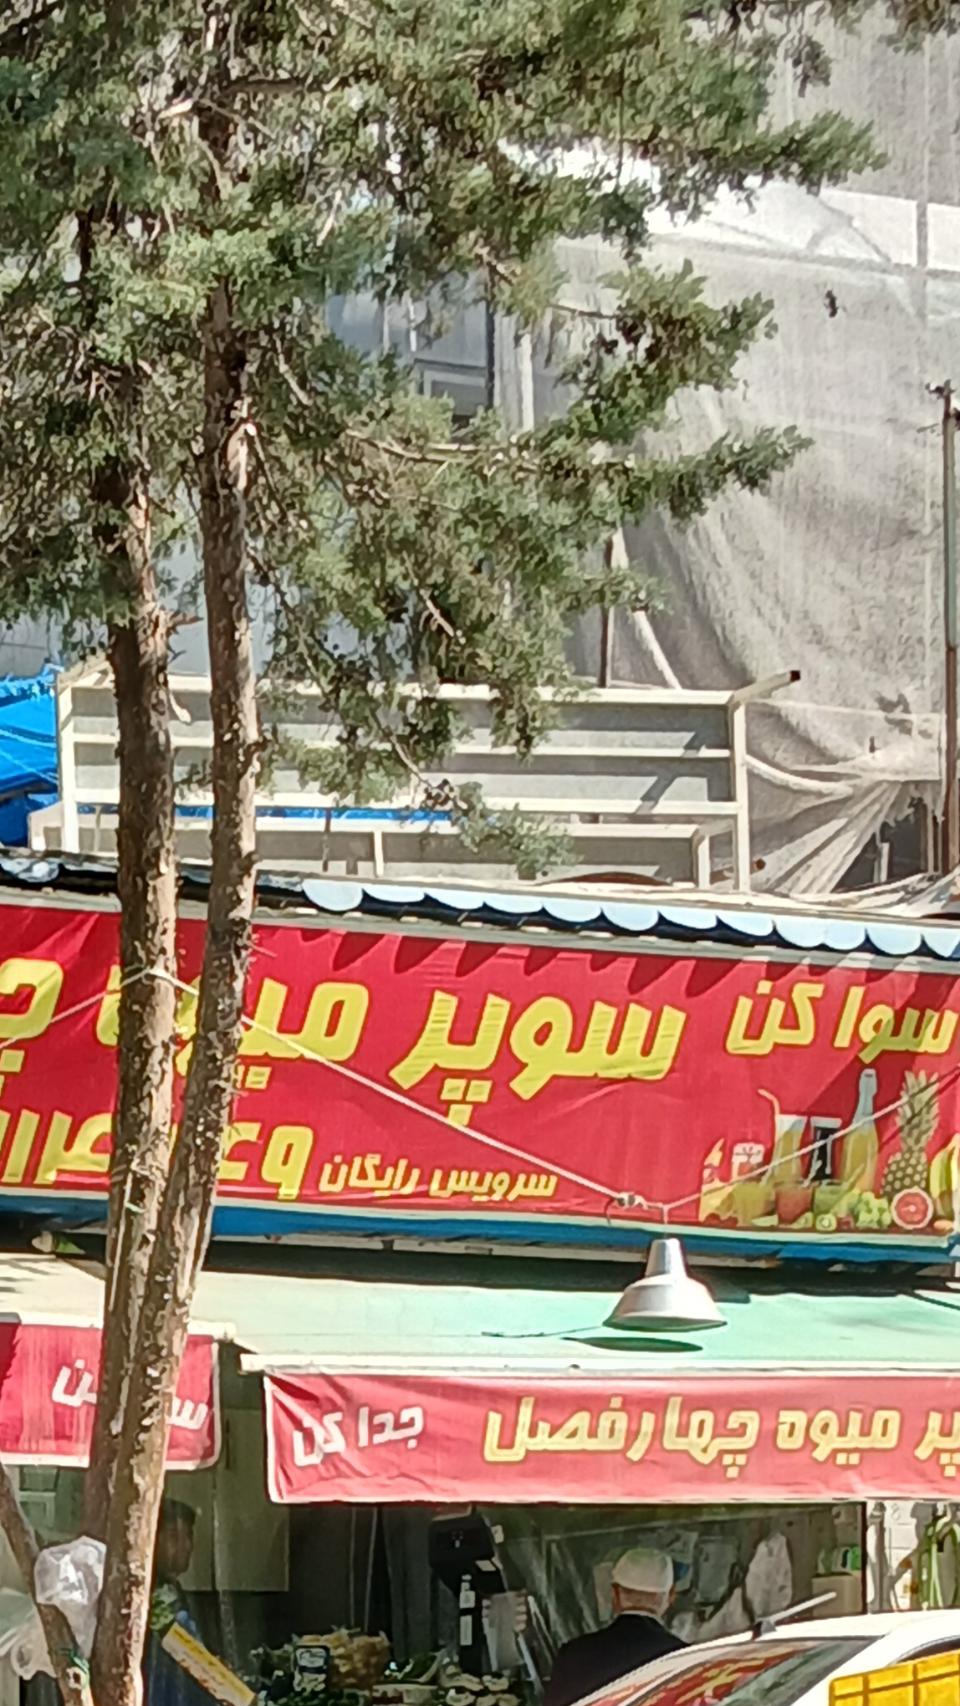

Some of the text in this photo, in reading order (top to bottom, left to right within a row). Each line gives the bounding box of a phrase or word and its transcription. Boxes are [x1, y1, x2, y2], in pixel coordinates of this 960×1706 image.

[726, 979, 958, 1064] سوا کن
[389, 990, 686, 1127] سوپر
[318, 1153, 558, 1201] سرویس رایگان
[51, 1359, 98, 1408] ن
[292, 1406, 424, 1467] جدا کن
[775, 1409, 901, 1466] میوه
